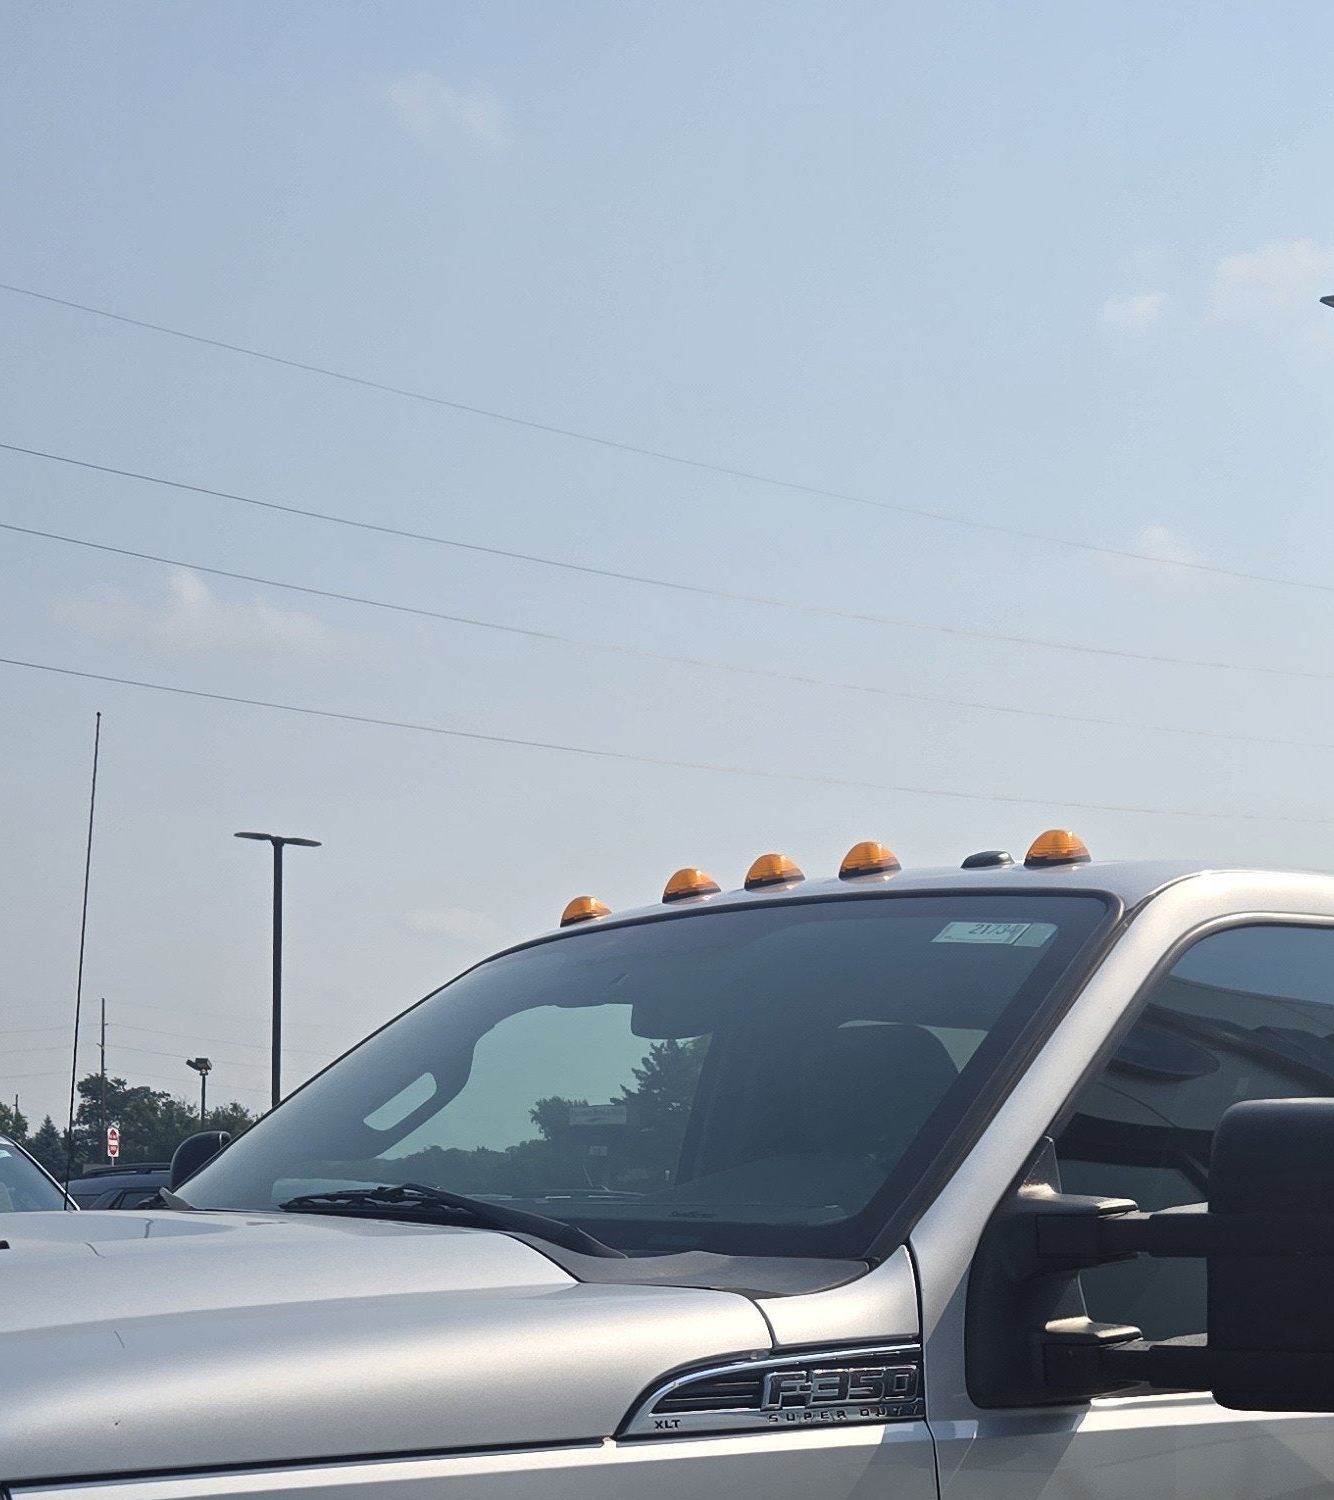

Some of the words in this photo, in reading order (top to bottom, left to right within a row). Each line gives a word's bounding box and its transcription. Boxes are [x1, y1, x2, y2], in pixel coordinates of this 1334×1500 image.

[762, 1364, 918, 1411] F-350
[768, 1410, 847, 1423] SUPER
[654, 1419, 681, 1430] XLT
